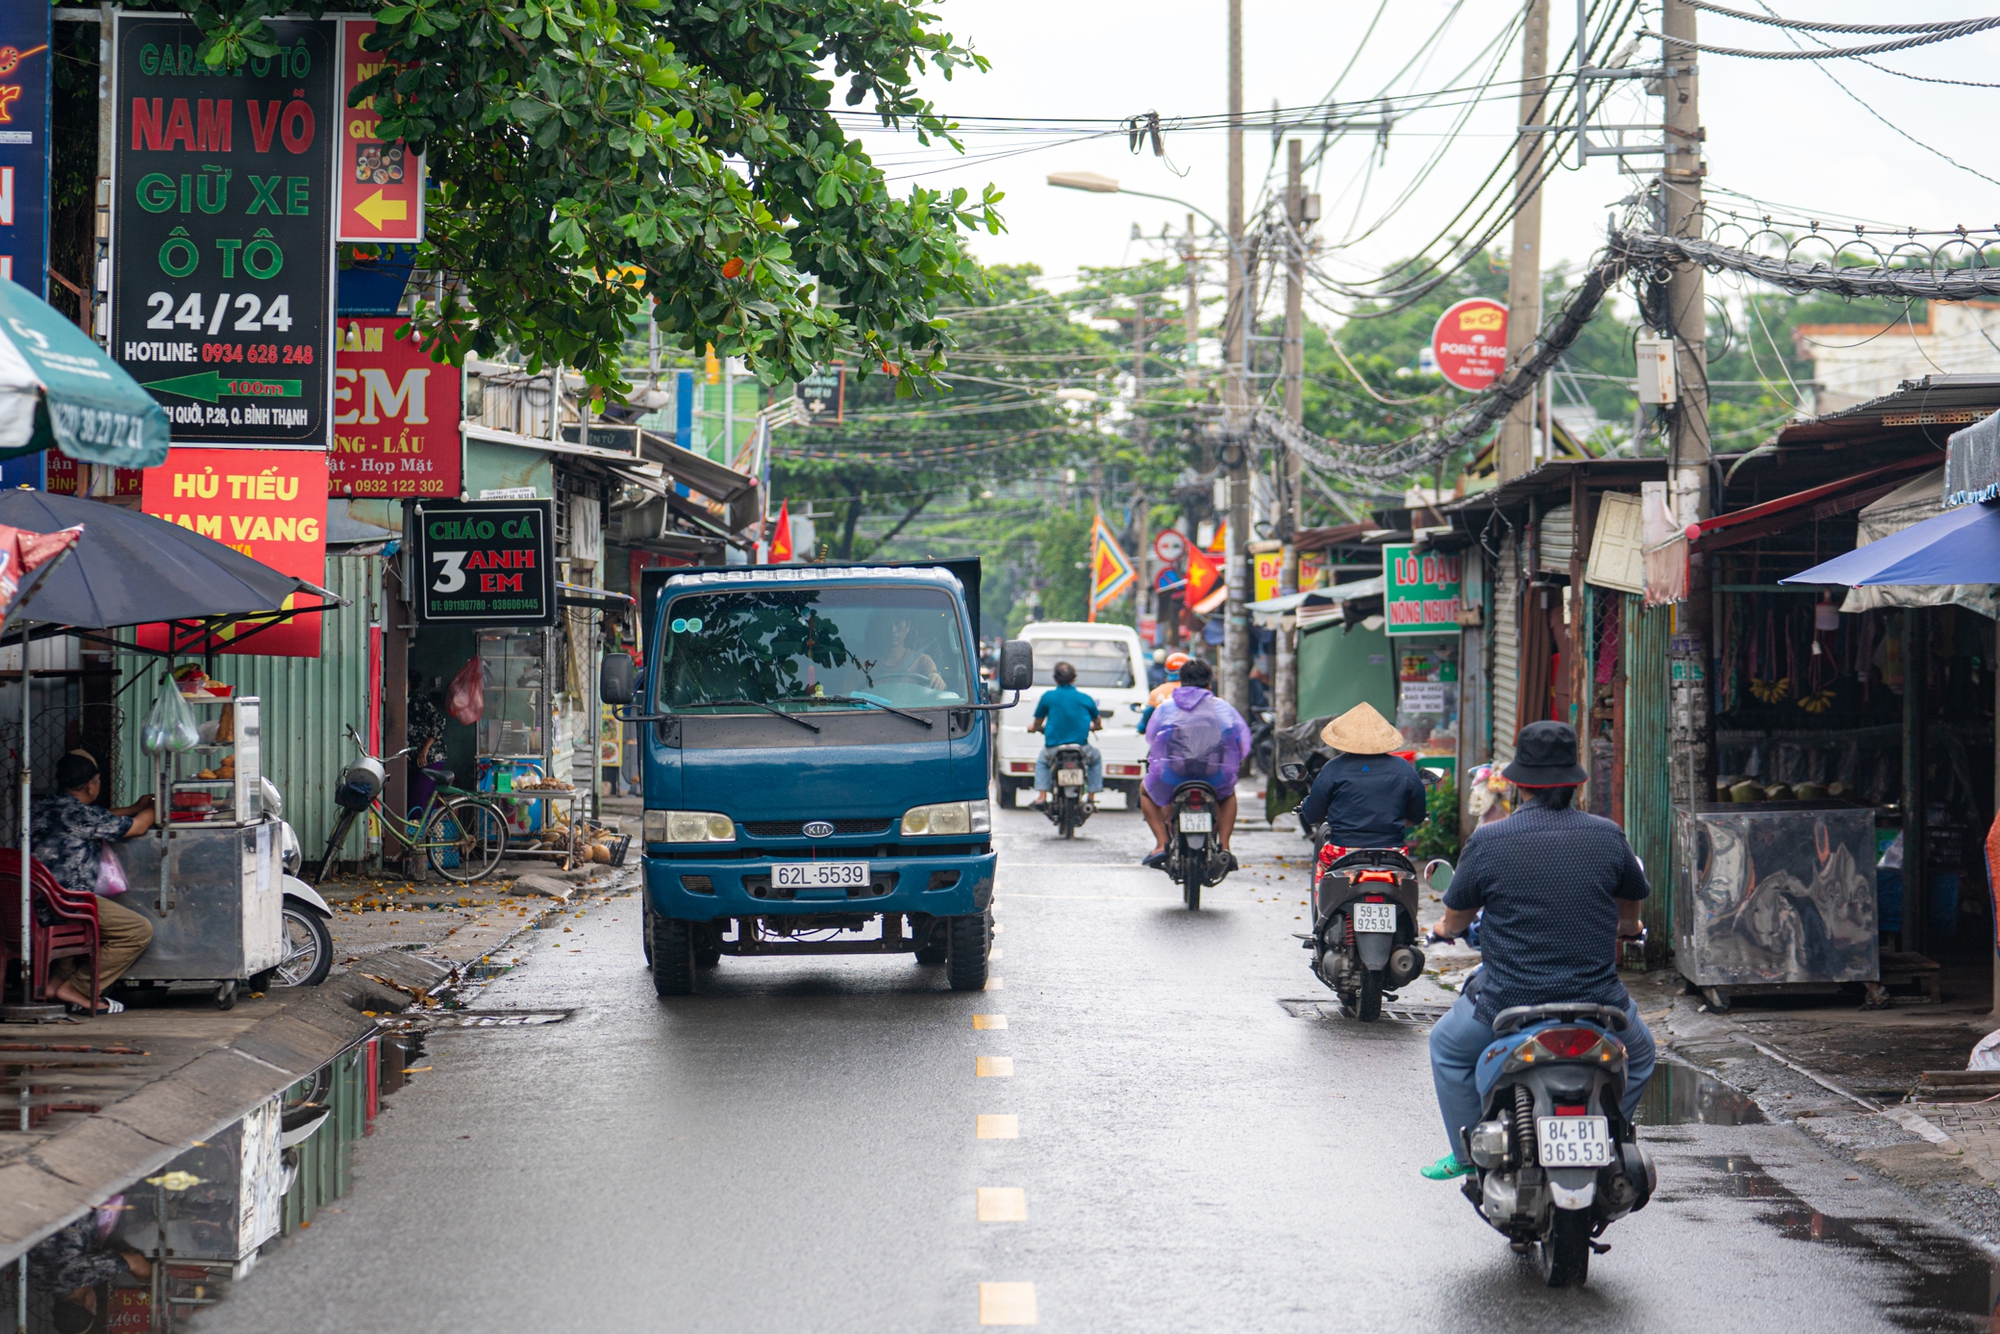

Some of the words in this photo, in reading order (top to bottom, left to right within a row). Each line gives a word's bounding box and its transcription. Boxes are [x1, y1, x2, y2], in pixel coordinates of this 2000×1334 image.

[280, 37, 311, 79] TÔ
[131, 97, 233, 152] NAM
[246, 88, 316, 155] VÕ
[135, 164, 233, 215] GIỮ
[245, 174, 310, 216] XE
[158, 226, 200, 278] Ô
[215, 227, 284, 280] TÔ
[146, 291, 293, 335] 24/24
[124, 341, 198, 362] HOTLINE:
[202, 343, 244, 363] 0934
[247, 344, 278, 364] 628
[282, 345, 314, 365] 248
[1440, 342, 1477, 357] PORK
[1480, 345, 1508, 359] SHO
[227, 380, 284, 396] 100m
[206, 407, 229, 427] P.28,
[231, 407, 243, 425] Q.
[244, 404, 270, 426] BÌNH
[272, 408, 308, 430] THẠNH
[383, 427, 425, 454] LẨU
[361, 458, 396, 475] Họp
[400, 458, 433, 475] Mặt
[173, 465, 219, 499] HỦ
[226, 465, 299, 501] TIẾU
[355, 479, 388, 492] 0932
[392, 479, 415, 492] 122
[419, 480, 444, 493] 302
[229, 515, 320, 543] VANG
[428, 517, 496, 540] CHÁO
[501, 515, 535, 539] CÁ
[432, 550, 469, 593] 3
[464, 549, 536, 569] ANH
[1395, 549, 1420, 586] LÒ
[480, 573, 524, 593] EM
[1422, 593, 1461, 625] NGUYÊ
[808, 825, 829, 834] KIA
[1357, 918, 1393, 930] 925.94
[1360, 905, 1390, 918] 59-X3
[1548, 1121, 1595, 1140] 84-B1
[1543, 1142, 1605, 1163] 365.53
